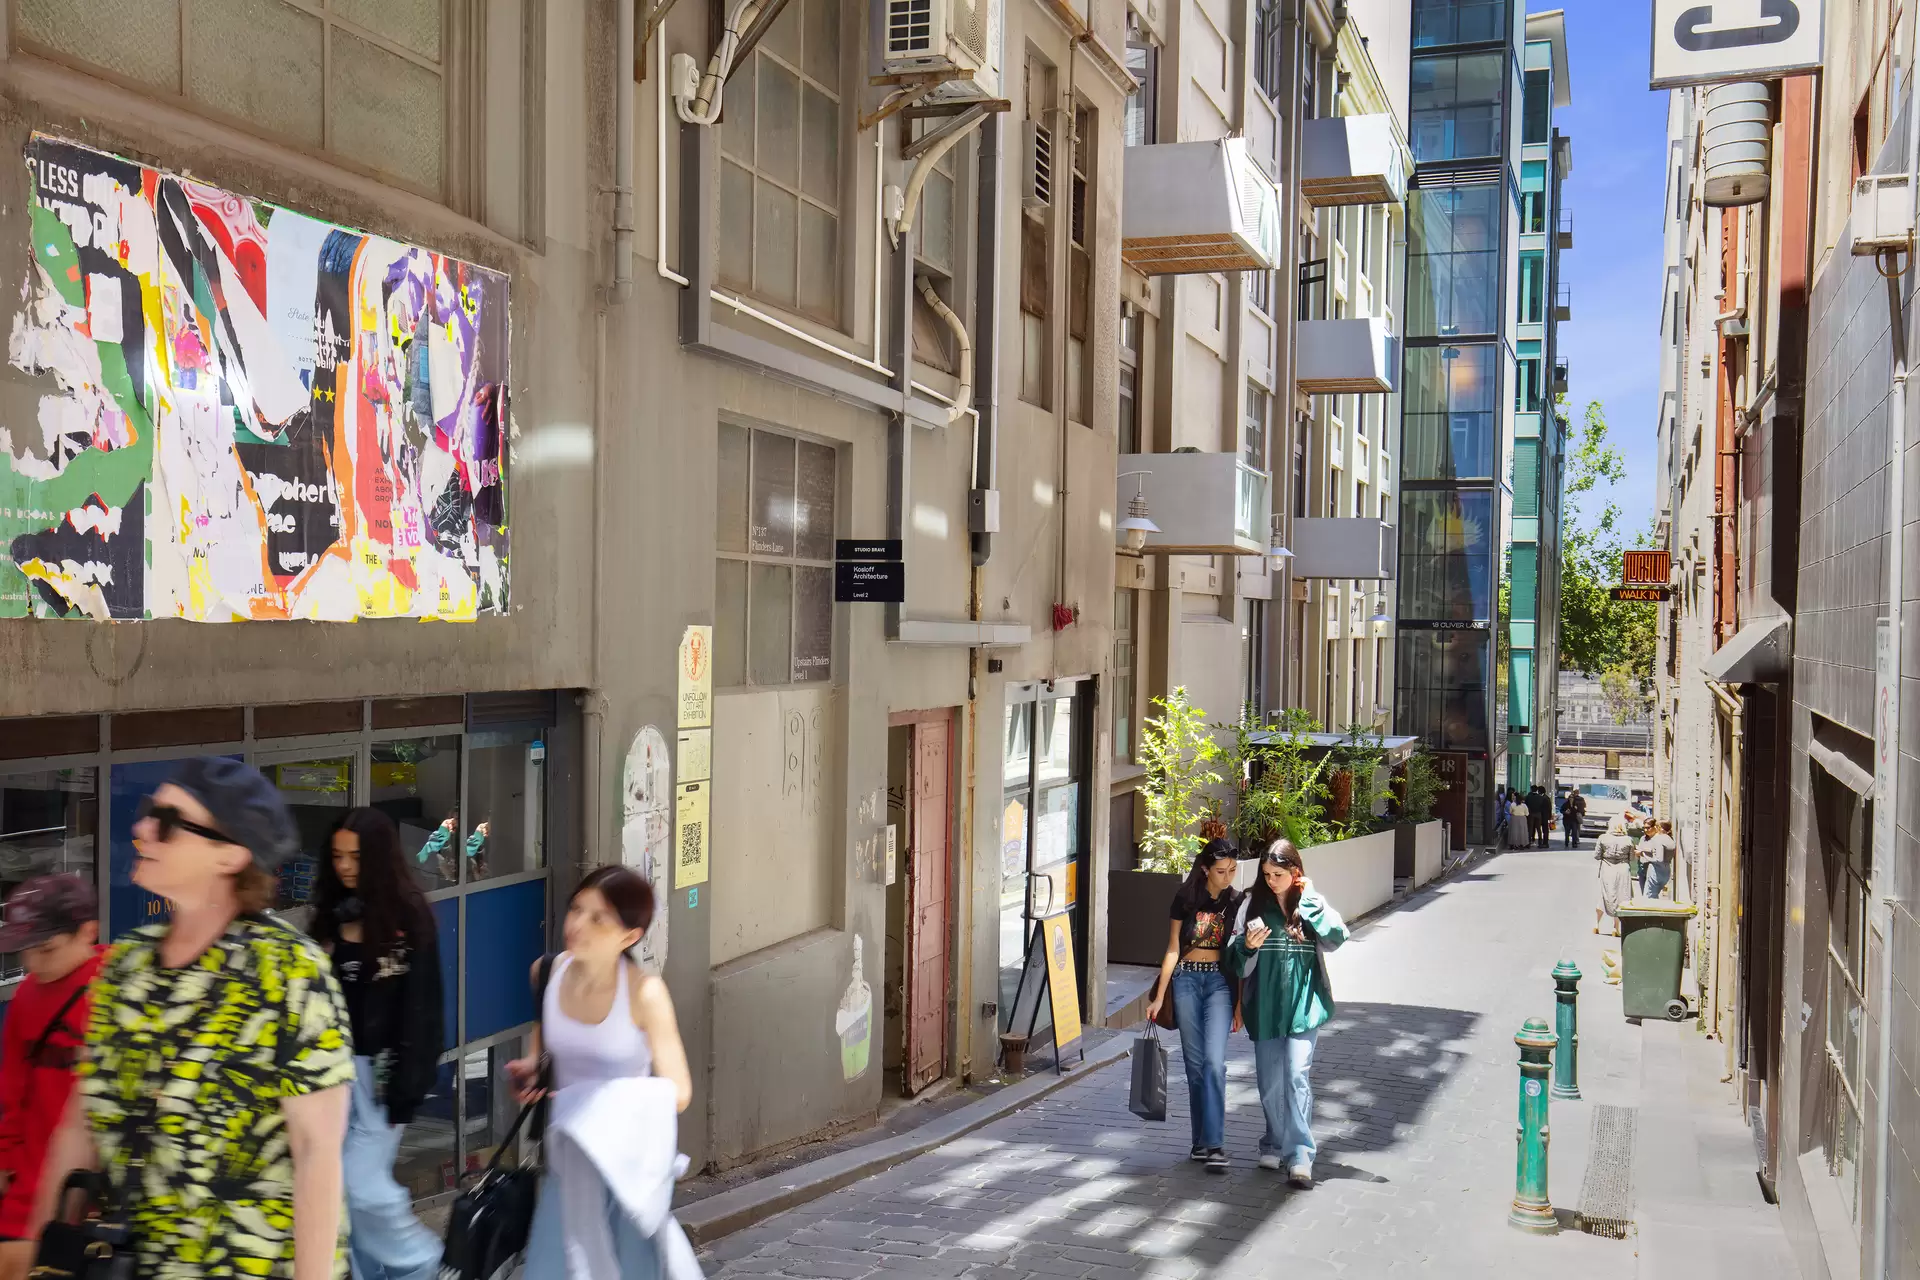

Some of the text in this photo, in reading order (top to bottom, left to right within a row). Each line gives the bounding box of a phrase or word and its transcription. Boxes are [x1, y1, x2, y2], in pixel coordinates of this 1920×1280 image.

[39, 159, 79, 198] LESS
[1465, 621, 1485, 629] LANE
[1441, 759, 1456, 773] 18
[147, 899, 160, 916] 10
